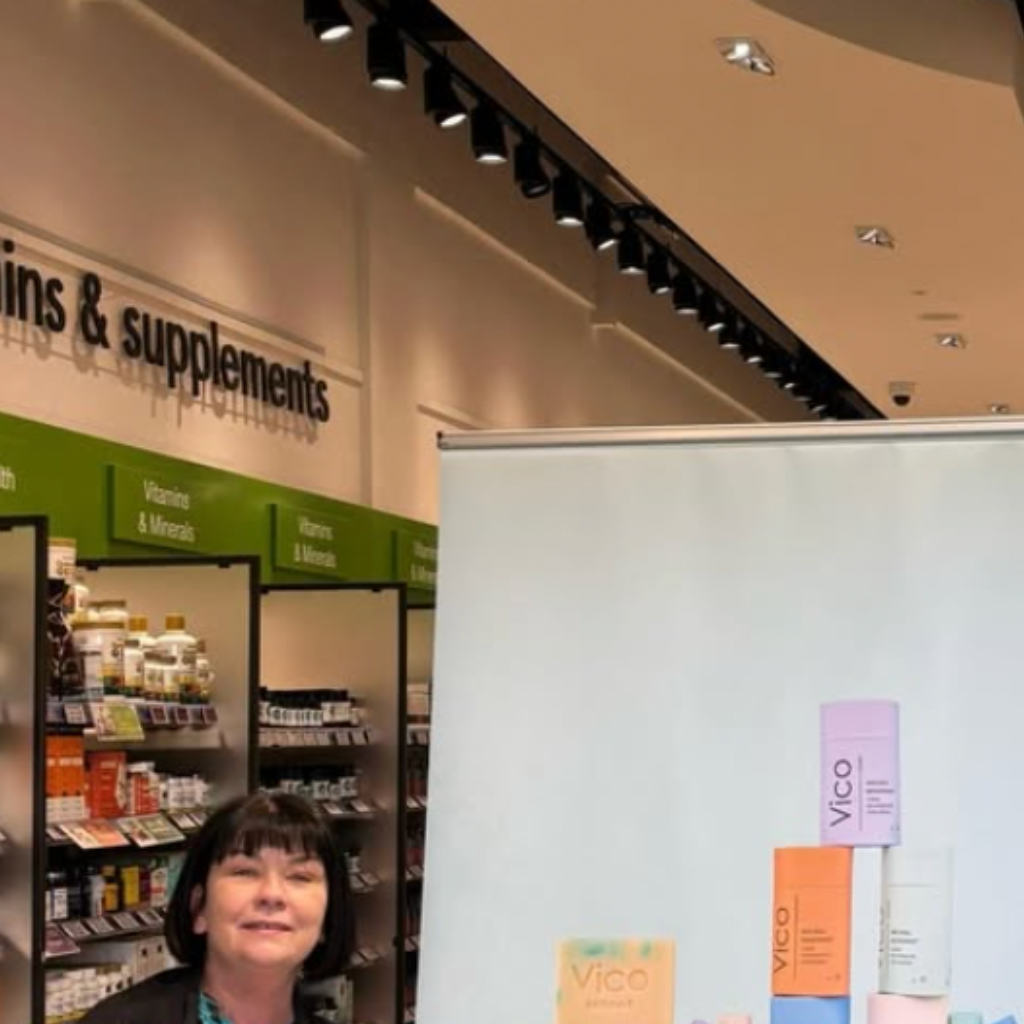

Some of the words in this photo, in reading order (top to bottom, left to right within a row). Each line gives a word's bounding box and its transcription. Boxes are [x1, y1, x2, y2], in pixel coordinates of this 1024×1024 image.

[0, 239, 65, 333] ins
[80, 272, 110, 349] &
[122, 307, 330, 422] supplements
[143, 479, 191, 510] Vitamins
[137, 511, 147, 534] &
[150, 513, 196, 543] Minerals
[828, 757, 854, 829] Vico
[773, 907, 791, 975] Vico
[571, 963, 649, 993] Vico
